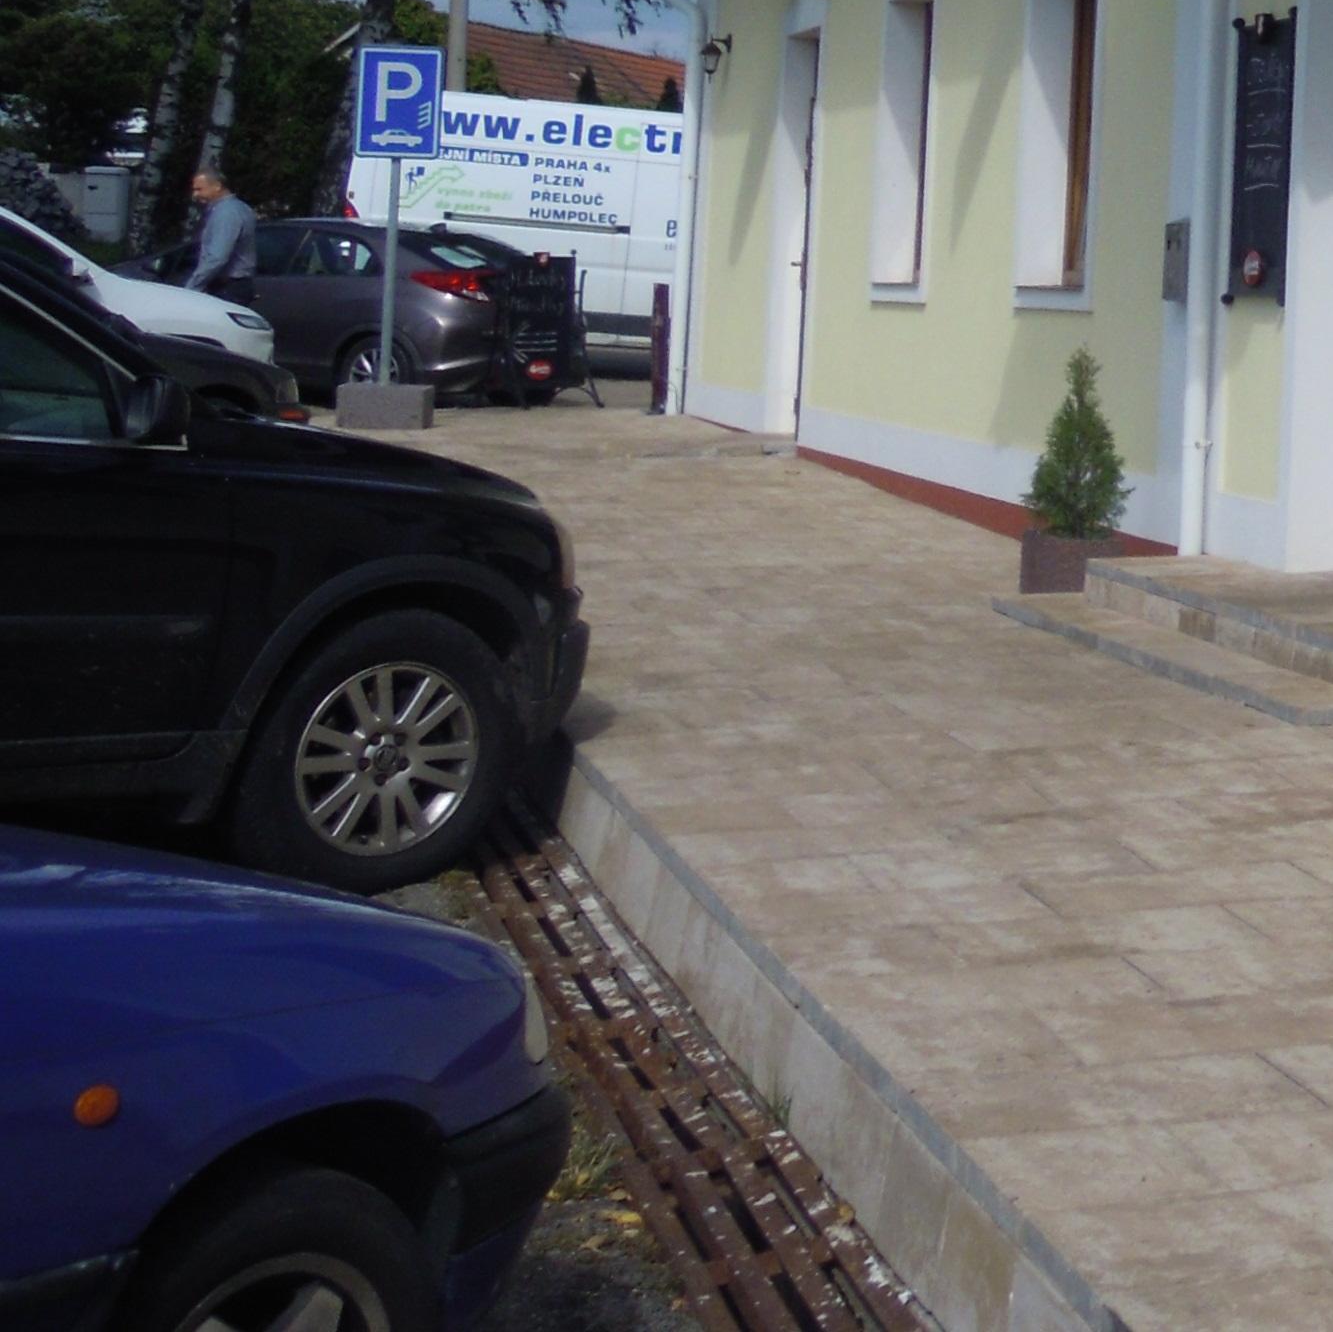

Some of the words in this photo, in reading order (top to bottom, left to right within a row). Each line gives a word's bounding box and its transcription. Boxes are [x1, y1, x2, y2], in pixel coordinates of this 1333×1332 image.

[376, 61, 422, 122] P
[442, 111, 682, 155] ww.electr
[473, 149, 521, 166] MÍSTA
[534, 157, 588, 171] PRAHA
[593, 162, 611, 173] 4x
[533, 173, 584, 187] PLZEŇ
[531, 189, 604, 206] PŘELOUČ
[529, 207, 618, 225] HUMPOLEC
